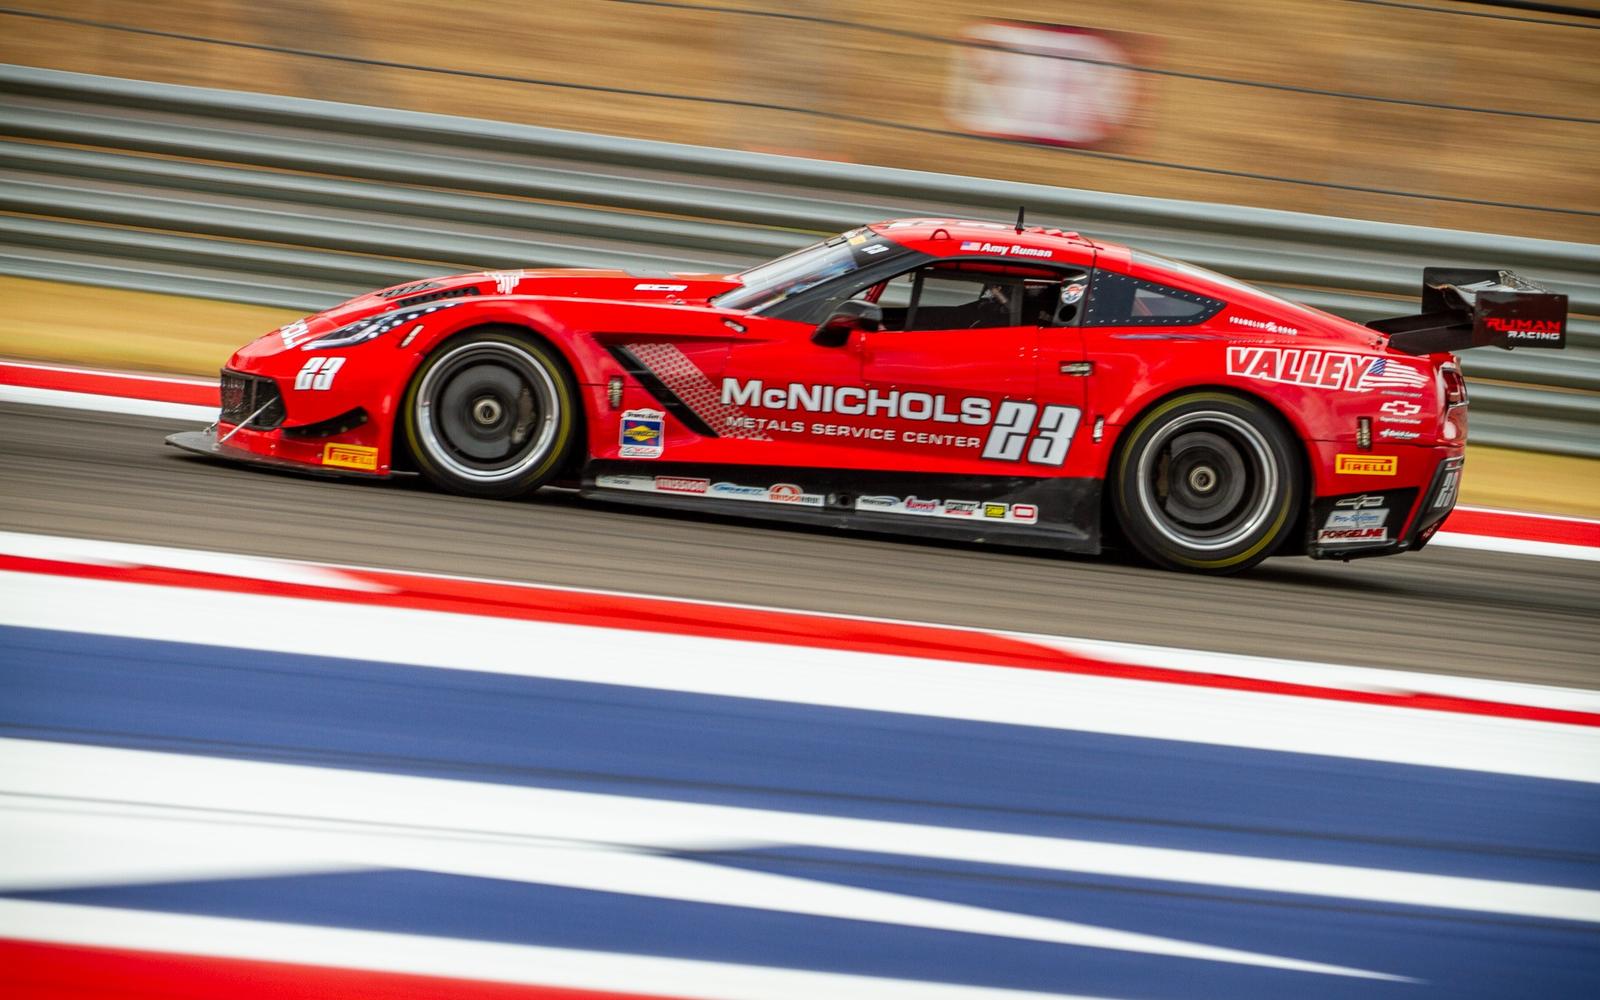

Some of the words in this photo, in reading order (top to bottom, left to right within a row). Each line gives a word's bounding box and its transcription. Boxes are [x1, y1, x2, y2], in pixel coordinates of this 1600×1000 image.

[980, 243, 1009, 256] Amy
[1010, 245, 1052, 258] Ruman
[1482, 317, 1561, 332] RUMAN
[1507, 330, 1560, 340] RACING
[294, 356, 346, 390] 23
[1226, 347, 1375, 392] VALLEY
[721, 377, 992, 426] McNICHOLS
[726, 416, 804, 433] METALS
[811, 422, 895, 442] SERVICE
[902, 430, 980, 448] CENTER
[980, 399, 1082, 467] 23
[328, 447, 374, 465] PIRELLI
[1340, 457, 1392, 472] PIRELLI
[1320, 528, 1385, 539] FORGELINE
